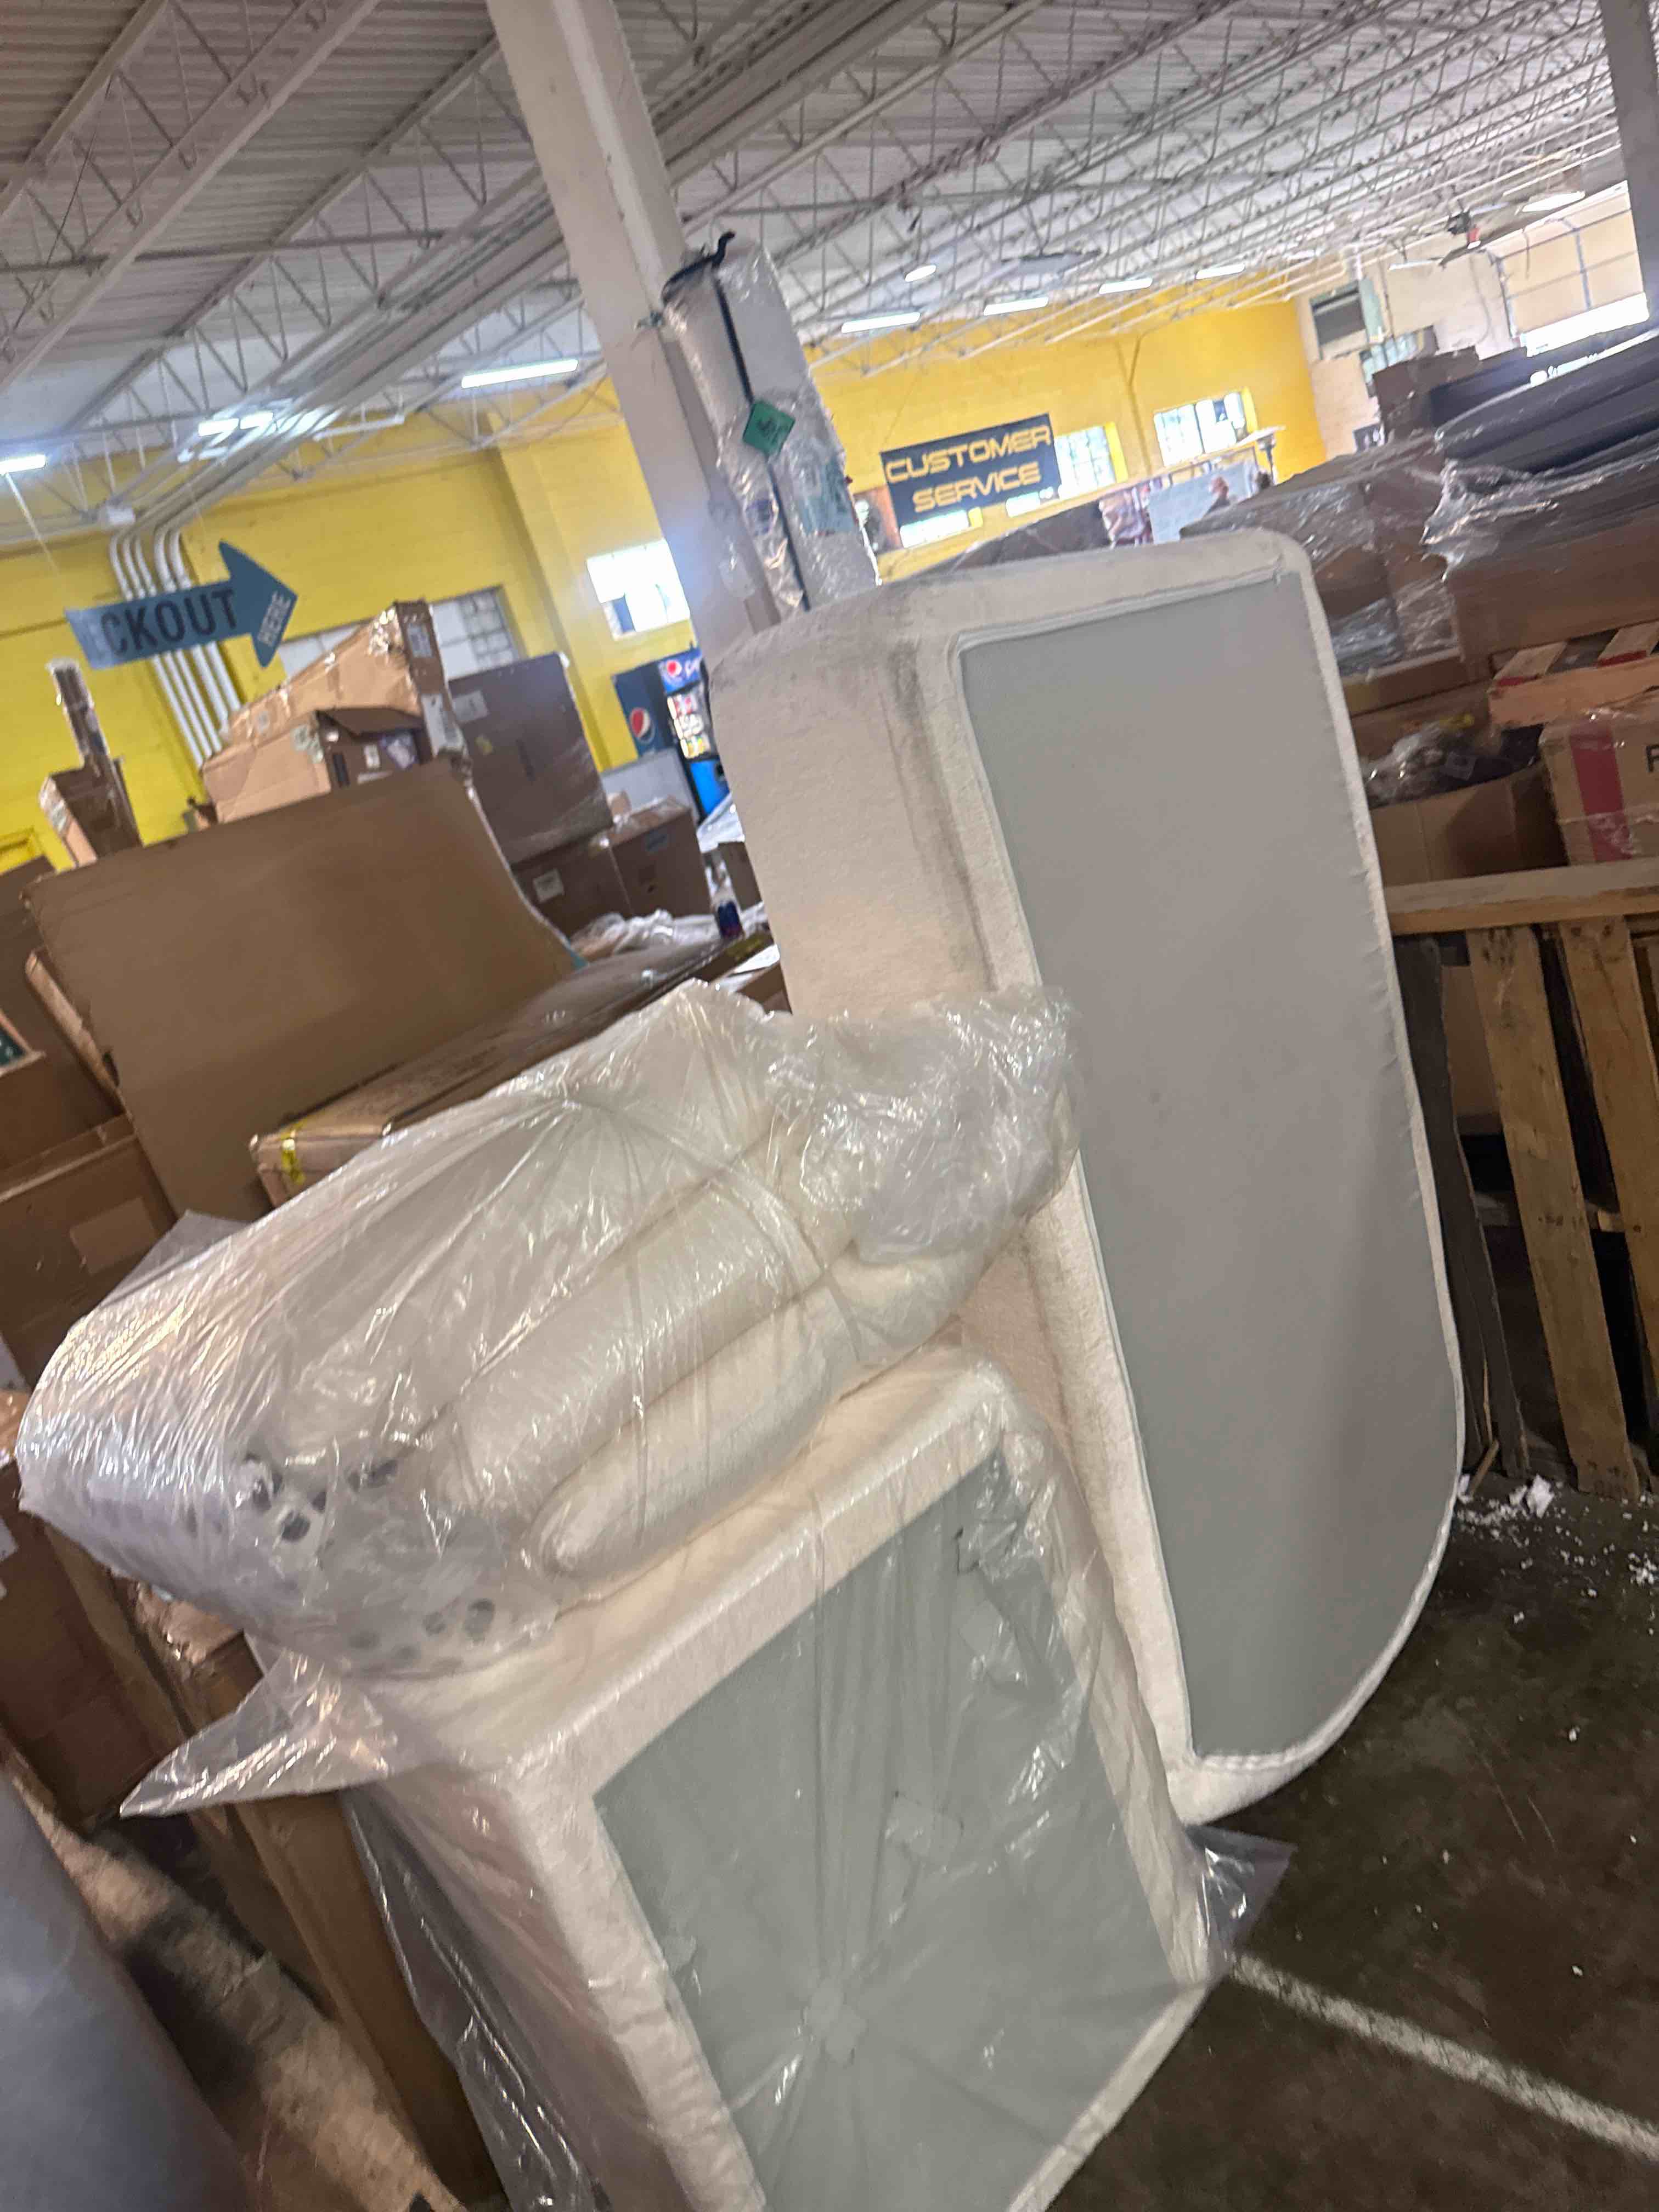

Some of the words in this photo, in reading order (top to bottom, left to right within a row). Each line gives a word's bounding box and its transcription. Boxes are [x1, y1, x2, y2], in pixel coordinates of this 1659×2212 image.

[885, 425, 1051, 483] CUSTOMER
[912, 461, 1041, 513] SERVICE
[92, 589, 238, 657] CKOUT
[257, 591, 291, 647] HERE
